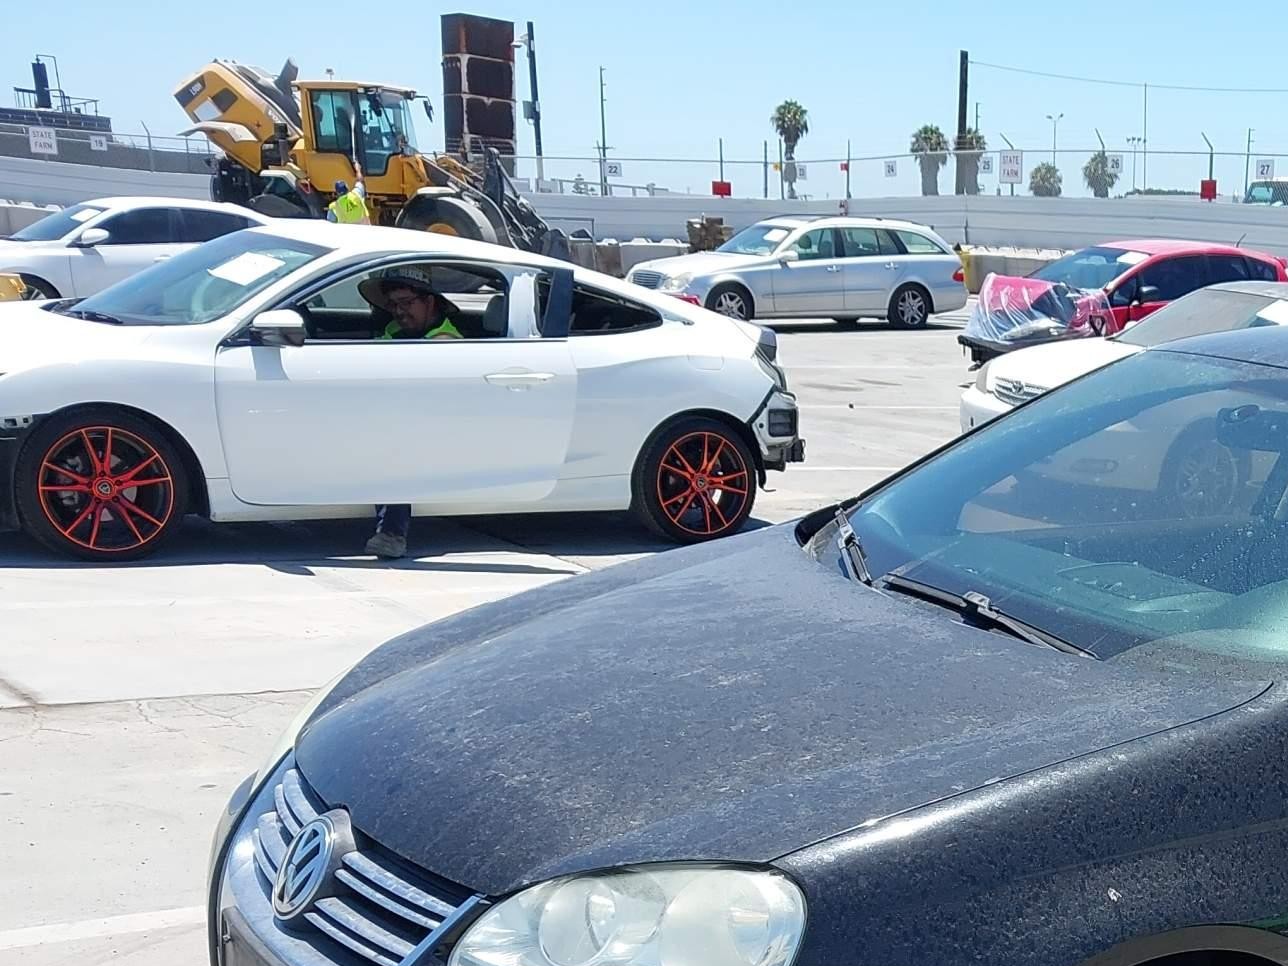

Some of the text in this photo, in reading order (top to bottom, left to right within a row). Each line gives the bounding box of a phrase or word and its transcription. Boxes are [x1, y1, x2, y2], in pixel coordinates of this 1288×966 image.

[33, 130, 53, 140] STATE
[34, 141, 53, 150] FARM
[1003, 155, 1019, 165] STATE
[1111, 158, 1120, 169] 26
[607, 165, 618, 175] 22
[1003, 167, 1019, 178] FARM
[1260, 164, 1270, 175] 27
